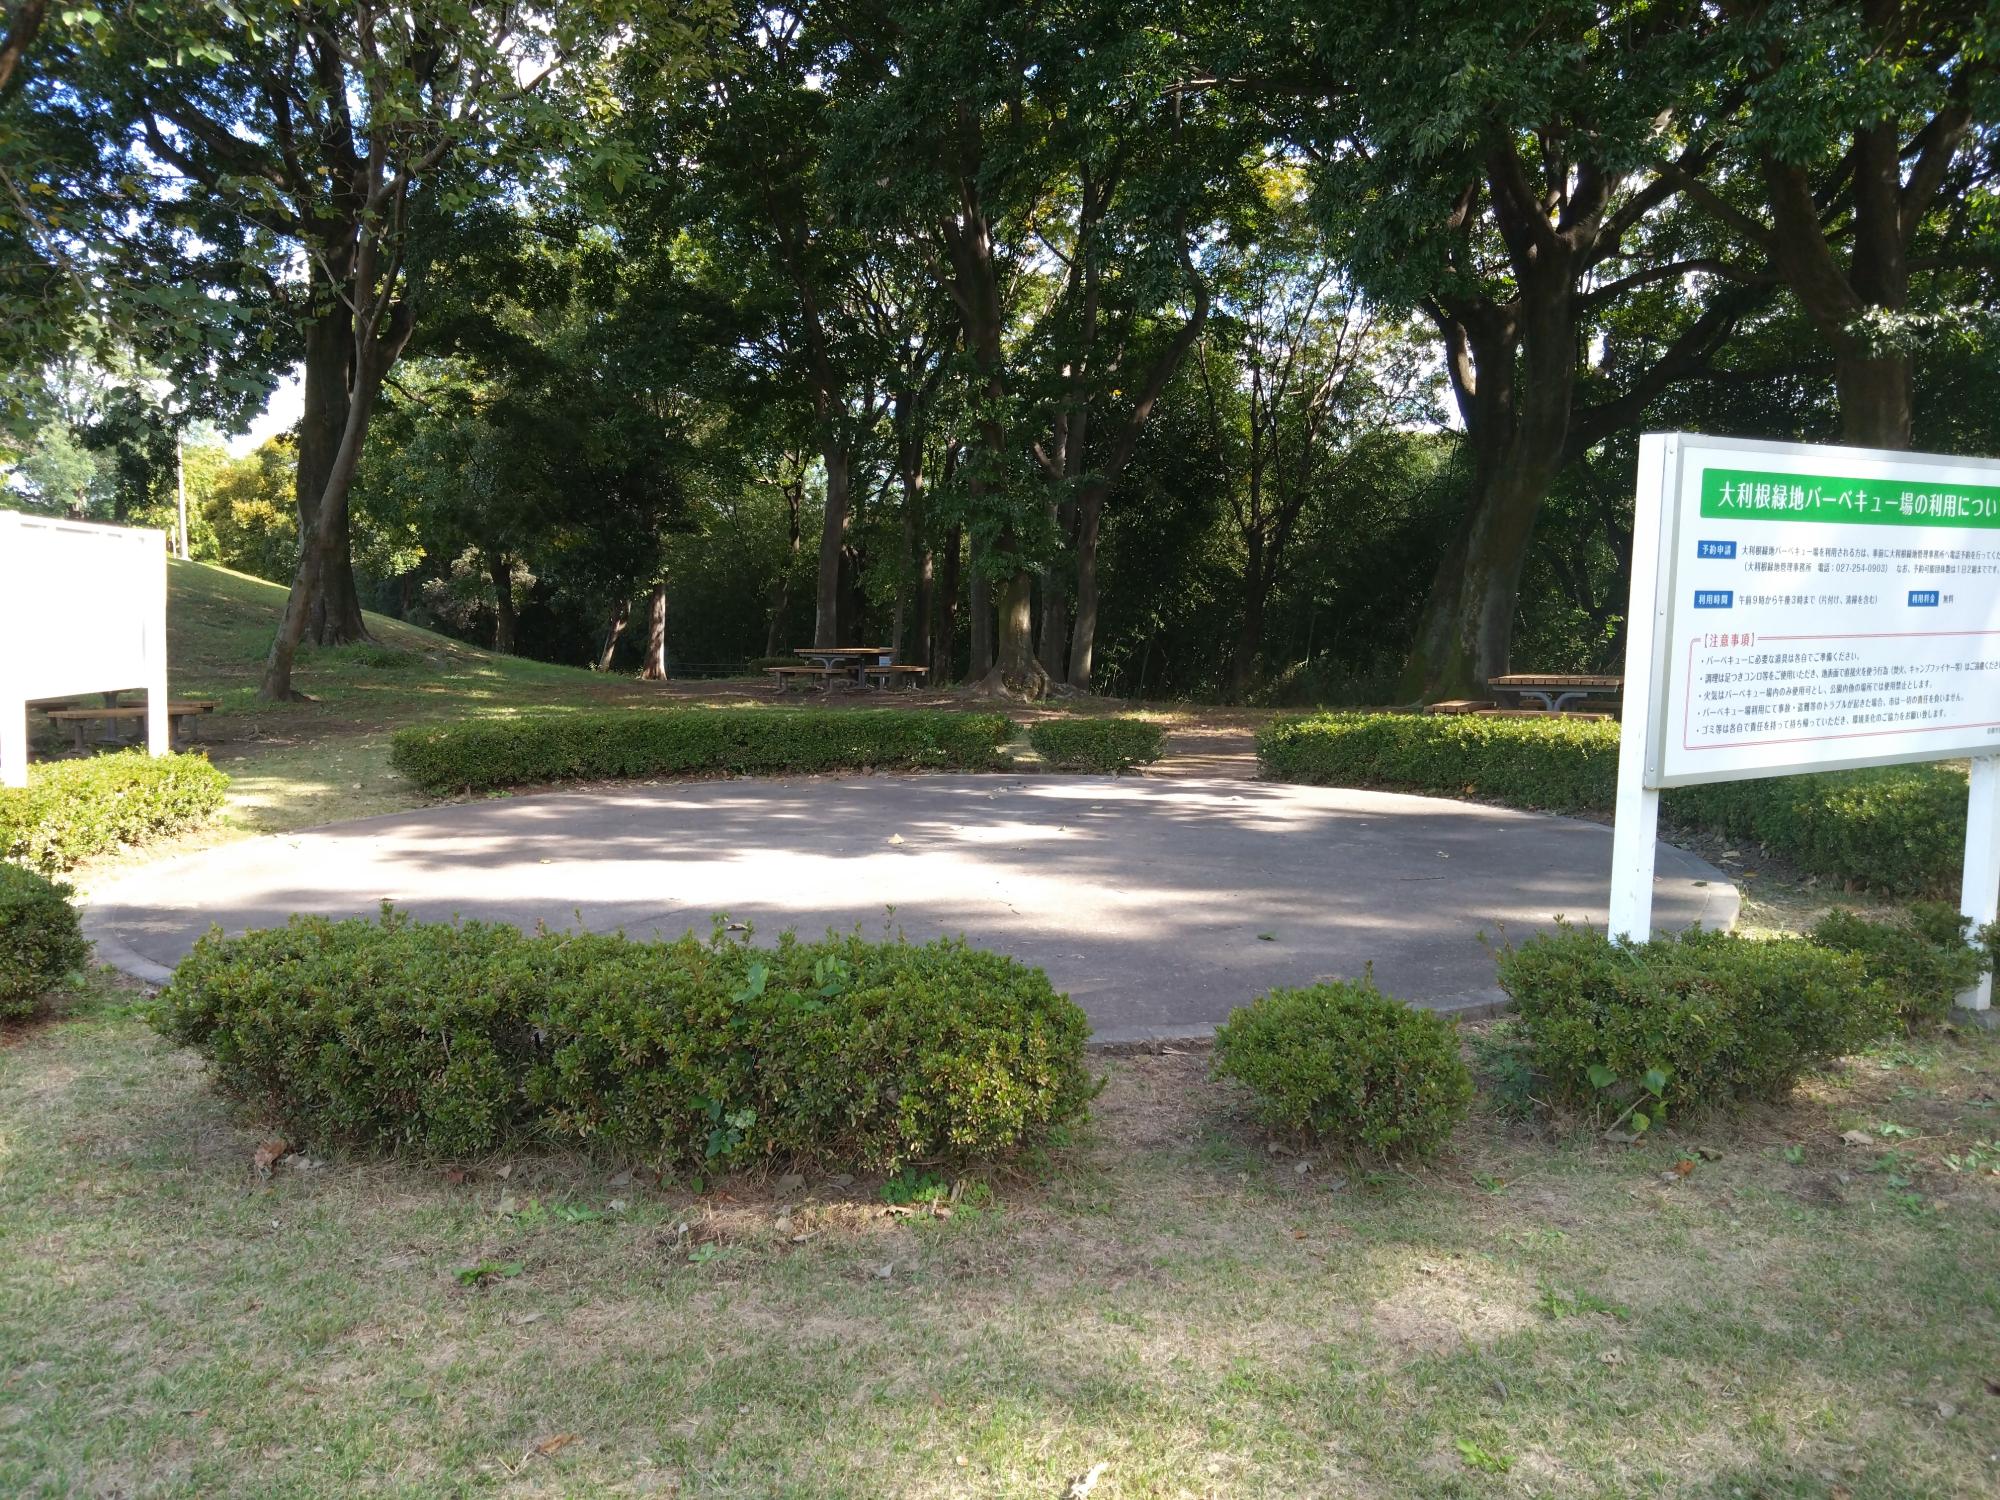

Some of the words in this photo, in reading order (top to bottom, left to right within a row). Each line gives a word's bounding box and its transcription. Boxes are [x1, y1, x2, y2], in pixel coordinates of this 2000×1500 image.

[1718, 480, 2000, 518] 大利根緑地バーベキュー場の利用につい
[1702, 544, 1731, 556] 予約申請
[1698, 594, 1728, 605] 利用時間
[1912, 593, 1935, 604] 利用料金
